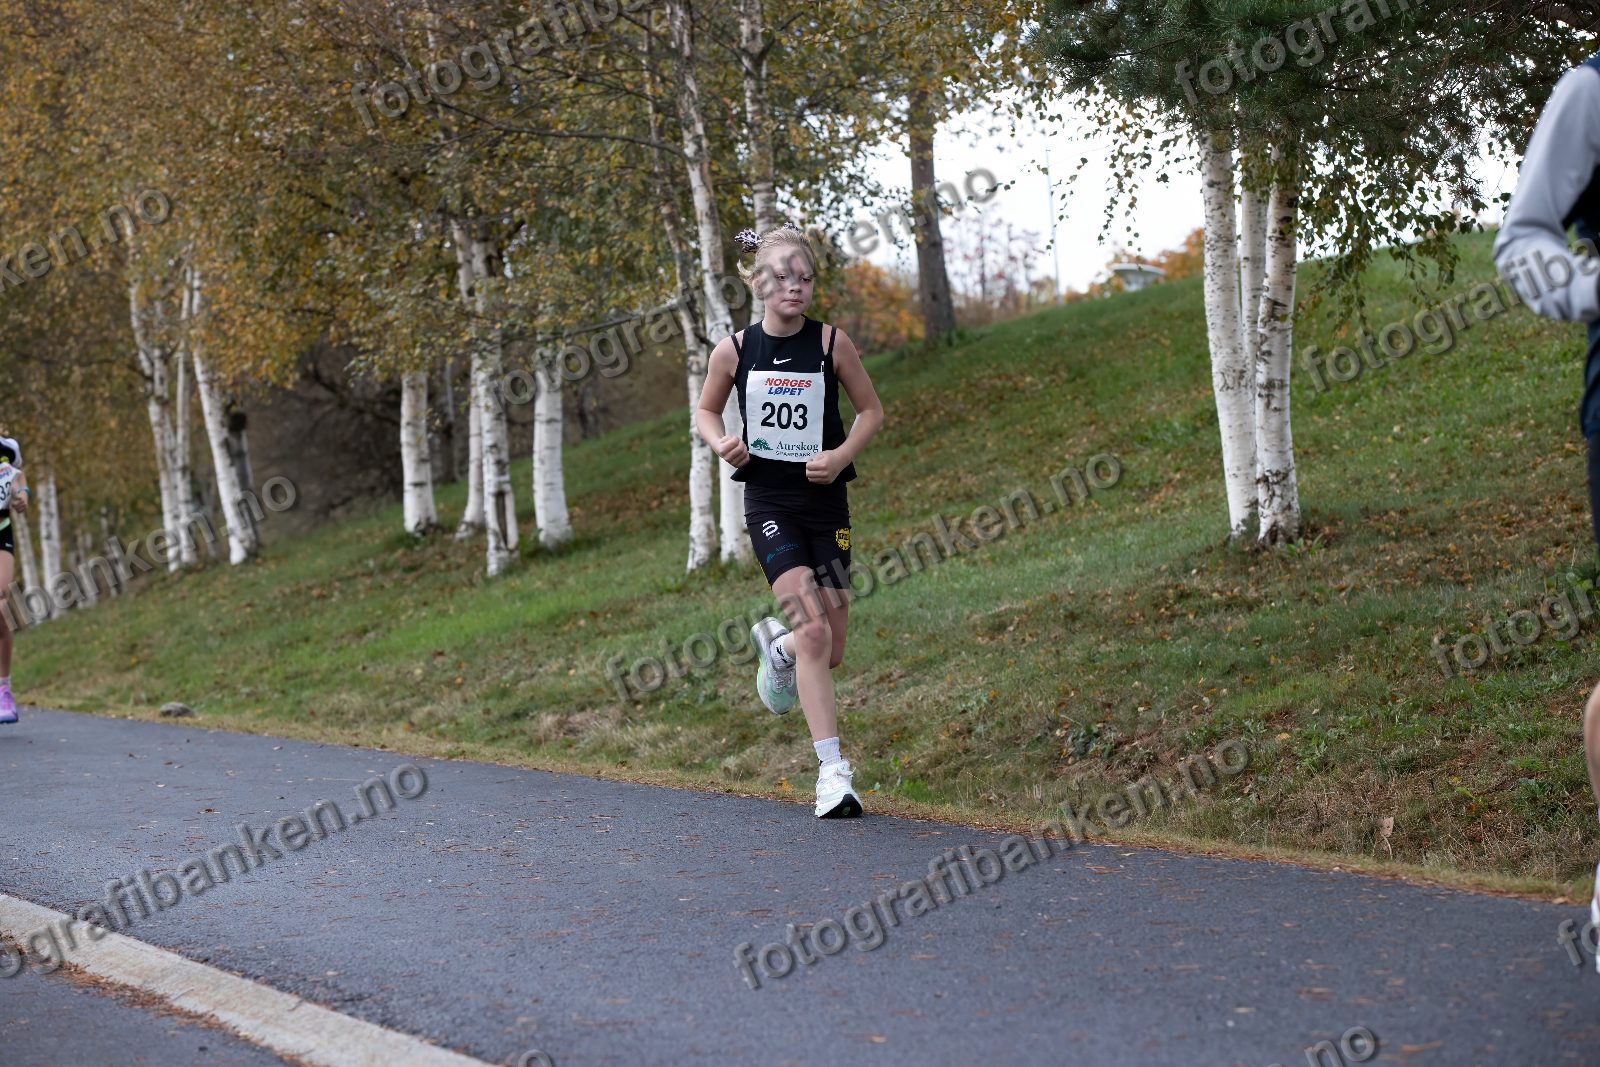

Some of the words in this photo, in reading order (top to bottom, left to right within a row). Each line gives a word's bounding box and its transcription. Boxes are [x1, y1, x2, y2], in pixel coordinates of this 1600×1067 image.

[765, 378, 812, 388] NORGES
[768, 387, 804, 396] LØPET
[761, 401, 808, 430] 203
[776, 441, 819, 453] Aurskog
